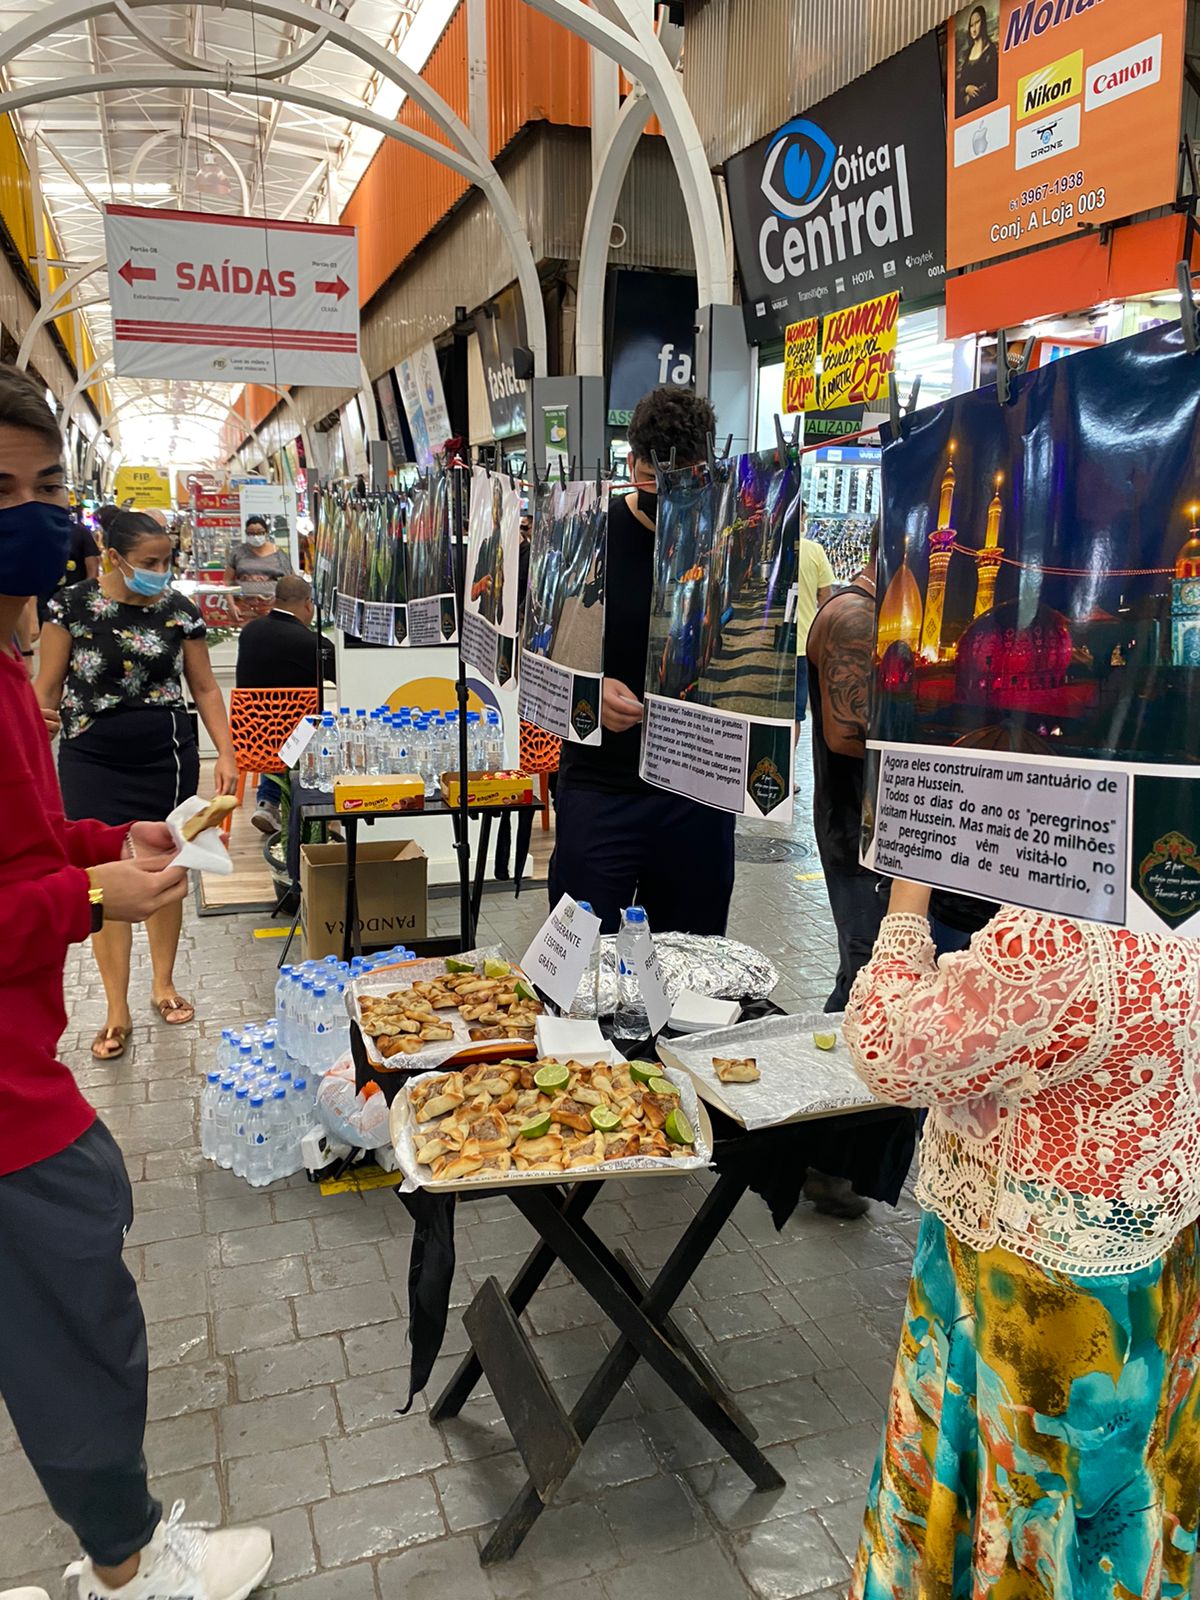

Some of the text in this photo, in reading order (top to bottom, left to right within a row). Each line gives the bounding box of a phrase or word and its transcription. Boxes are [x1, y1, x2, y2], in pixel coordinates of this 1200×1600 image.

[1002, 0, 1101, 52] Mon
[1024, 76, 1072, 112] Nikon
[1092, 56, 1153, 95] Canon
[834, 144, 891, 190] Ótica
[1030, 140, 1064, 159] DRONE
[1020, 170, 1084, 207] 3967-1938
[759, 144, 914, 284] Central
[990, 187, 1106, 243] Conj. A Loja 003
[176, 259, 297, 297] SAÍDAS
[852, 269, 874, 286] HOYA
[927, 265, 946, 278] 001A
[658, 344, 696, 384] fa
[884, 771, 964, 794] luz para Hussein.
[885, 756, 1118, 793] Agora eles construíram um santuário de
[880, 804, 1116, 854] visitam Hussein. Mas mais de 20 milhões
[886, 788, 1116, 834] Todos os dias do ano os "peregrinos"
[876, 852, 903, 870] Arbain.
[878, 838, 942, 860] quadragésimo
[950, 852, 970, 866] dia
[978, 857, 992, 870] de
[999, 864, 1020, 878] seu
[1104, 884, 1114, 895] o
[879, 820, 1115, 875] de peregrinos vêm visitá-lo no
[538, 953, 558, 976] GRÁTIS
